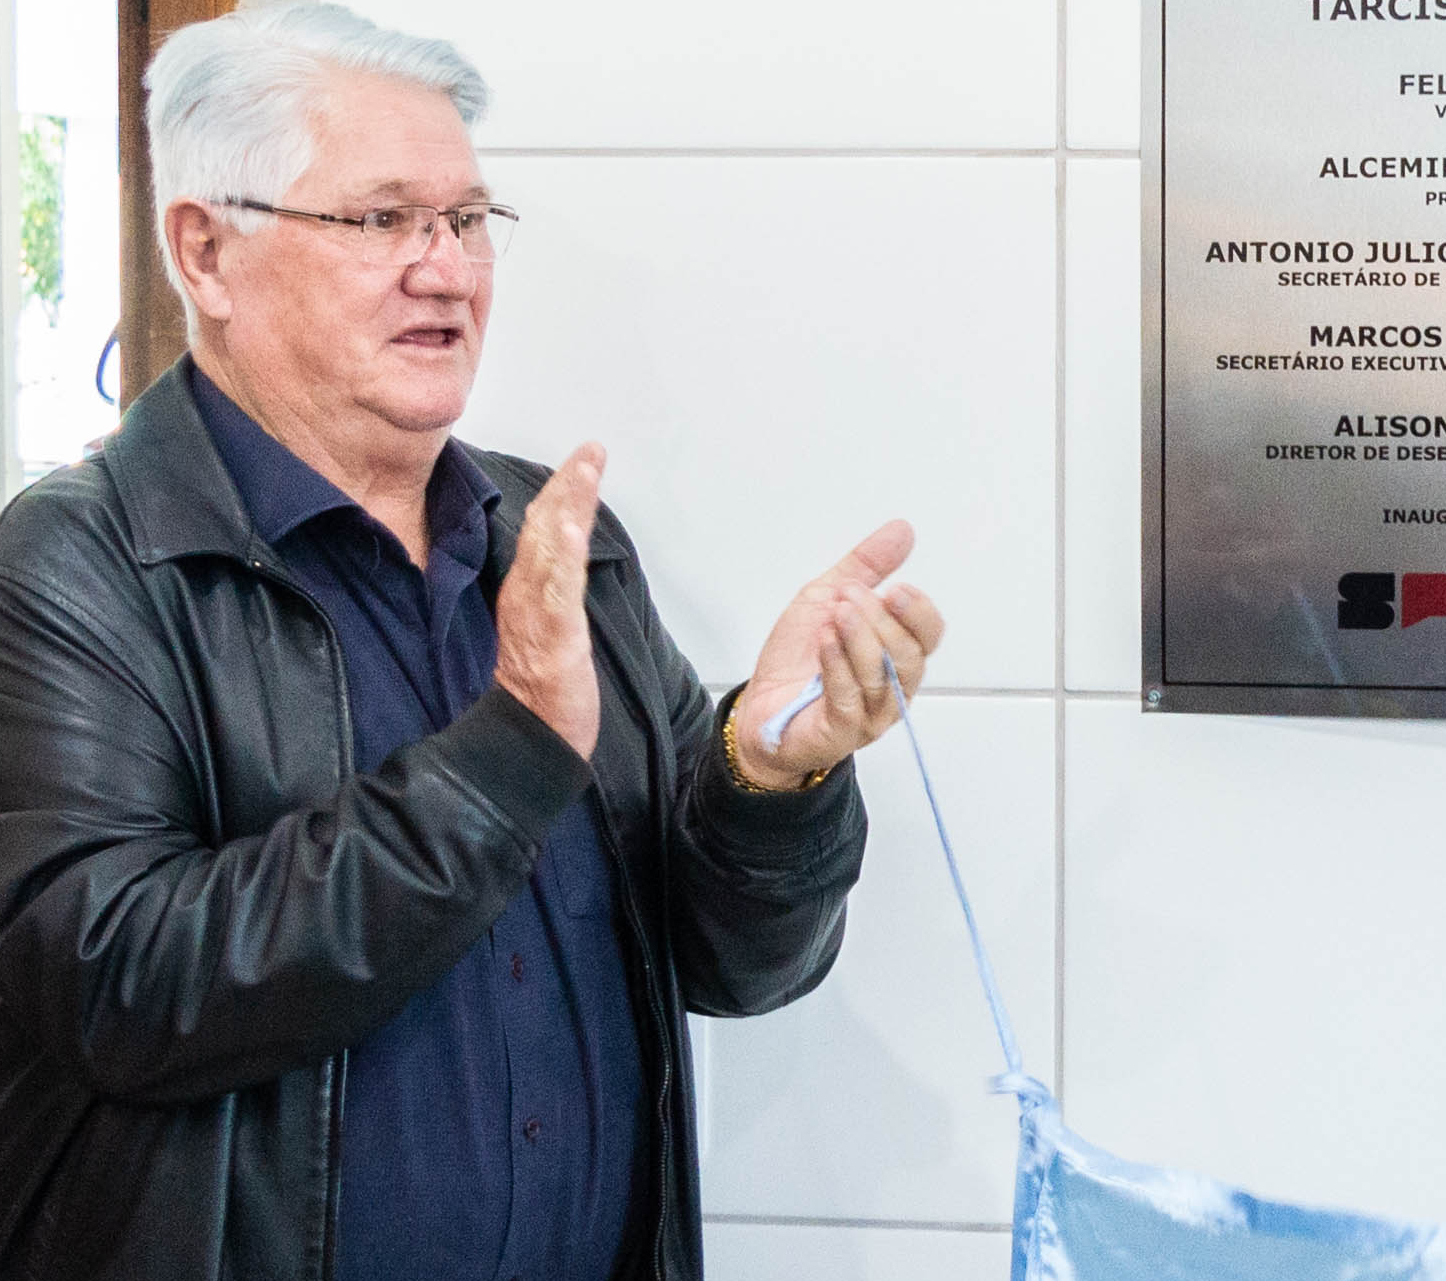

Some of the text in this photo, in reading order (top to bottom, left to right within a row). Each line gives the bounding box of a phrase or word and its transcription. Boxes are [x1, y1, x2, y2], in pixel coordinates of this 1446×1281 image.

[1204, 240, 1355, 264] ANTONIO
[1277, 266, 1407, 288] SECRETÁRIO
[1414, 271, 1441, 287] DE
[1309, 324, 1443, 349] MARCOS
[1215, 350, 1345, 371] SECRETÁRIO
[1265, 444, 1357, 461] DIRETOR
[1363, 445, 1390, 461] DE
